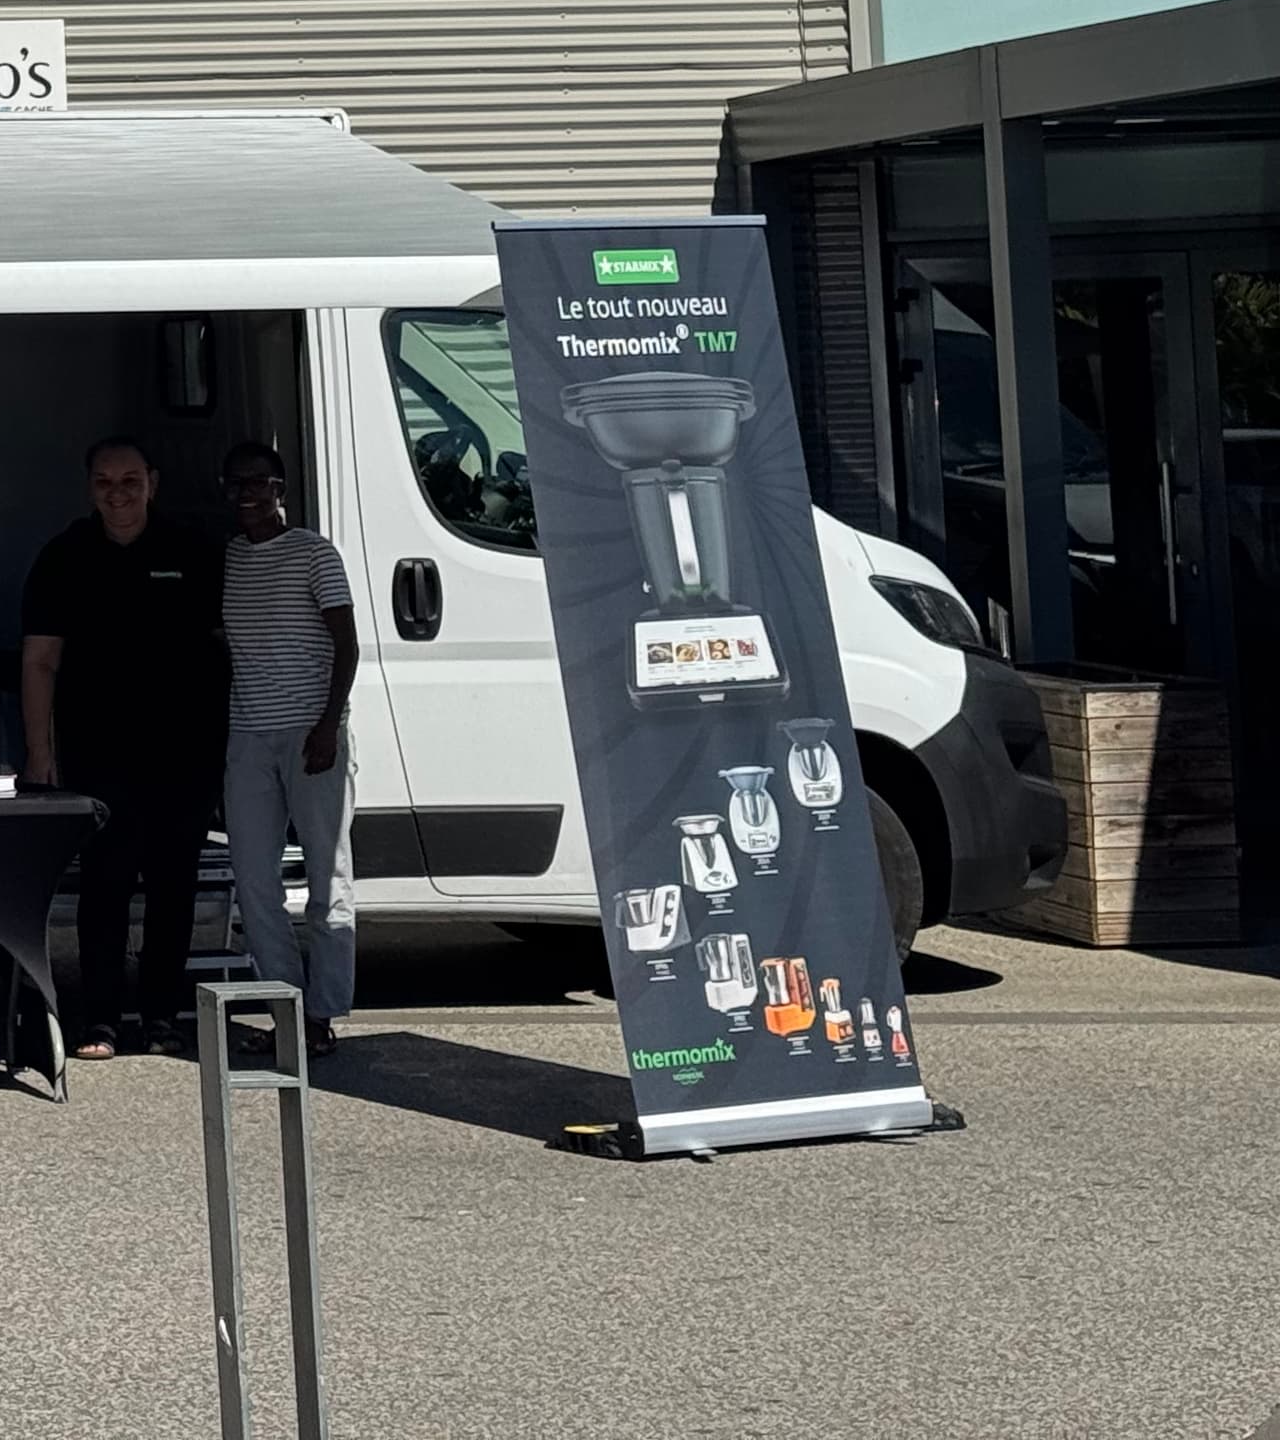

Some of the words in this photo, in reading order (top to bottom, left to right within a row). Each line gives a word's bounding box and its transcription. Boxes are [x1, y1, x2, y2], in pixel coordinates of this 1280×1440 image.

[613, 259, 661, 274] STARMIX
[557, 296, 584, 320] Le
[587, 296, 634, 319] tout
[637, 296, 728, 318] nouveau
[694, 331, 738, 354] TM7
[632, 1037, 737, 1071] thermomix
